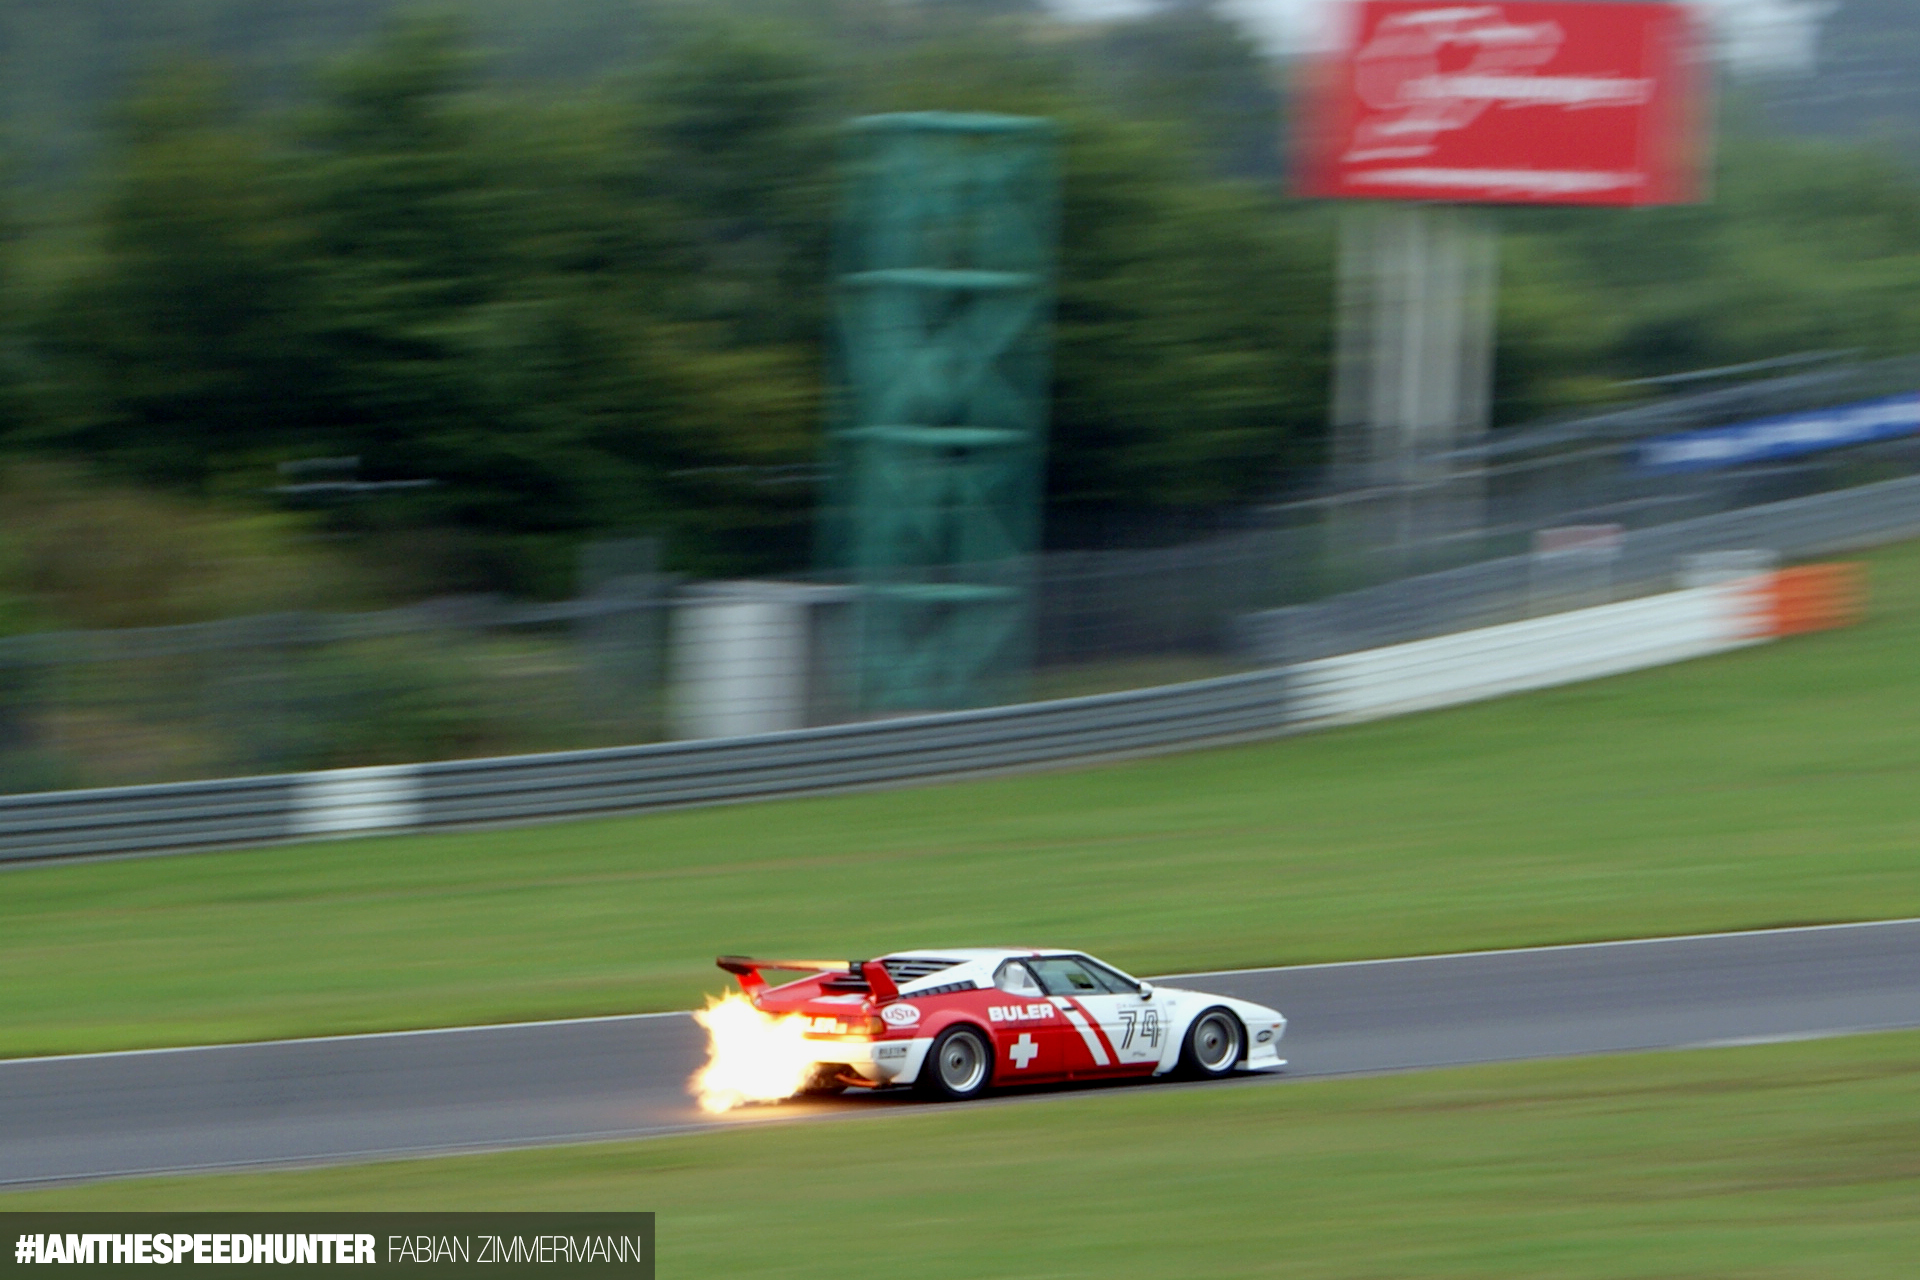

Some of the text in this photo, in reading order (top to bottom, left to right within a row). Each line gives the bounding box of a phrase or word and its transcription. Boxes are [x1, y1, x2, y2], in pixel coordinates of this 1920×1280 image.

[884, 1008, 917, 1021] LISTA
[988, 1003, 1055, 1022] BULER
[1118, 1009, 1161, 1050] 74
